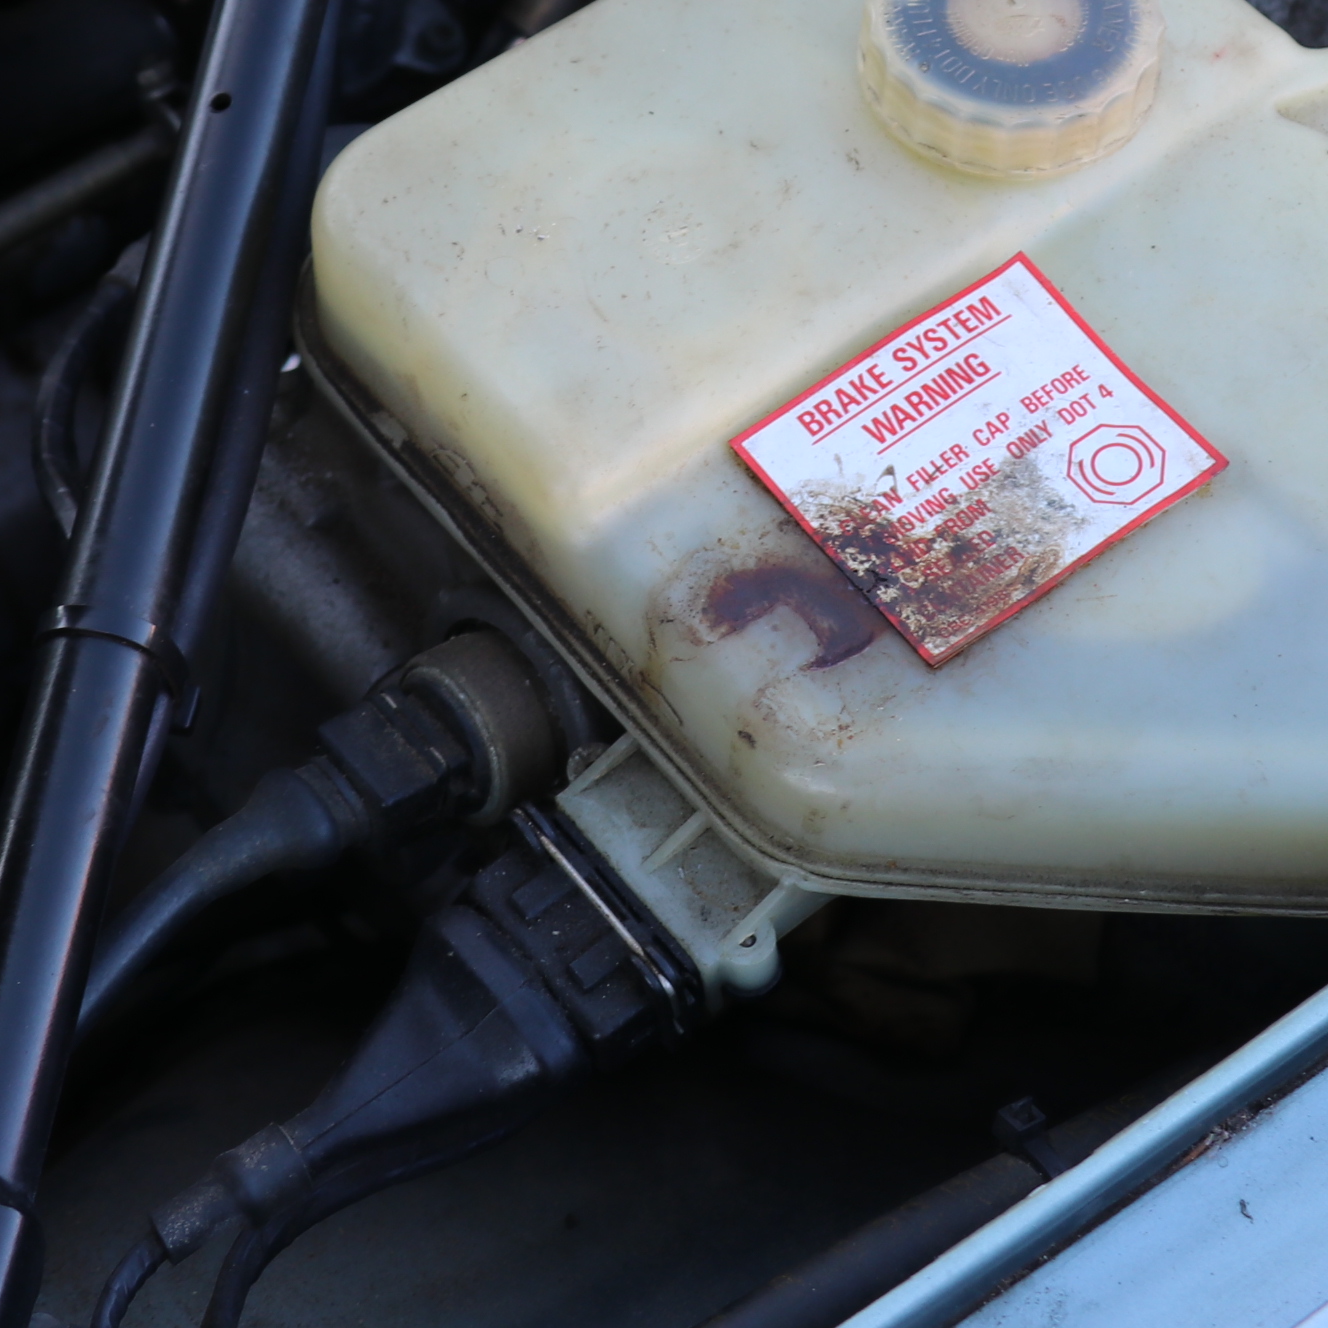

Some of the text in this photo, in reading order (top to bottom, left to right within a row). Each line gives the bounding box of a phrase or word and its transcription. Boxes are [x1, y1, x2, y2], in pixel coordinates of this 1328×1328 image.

[796, 295, 1004, 437] BRAKE SYSTEM
[861, 352, 992, 445] WARNING
[906, 443, 970, 492] FILLER
[972, 412, 1011, 447] CAP
[1020, 363, 1091, 413] BEFORE
[959, 457, 1002, 491] USE
[1006, 419, 1053, 460] ONLY
[1058, 394, 1097, 427] DOT
[1096, 383, 1114, 403] 4
[922, 529, 997, 578] SEED
[934, 498, 993, 536] FROM
